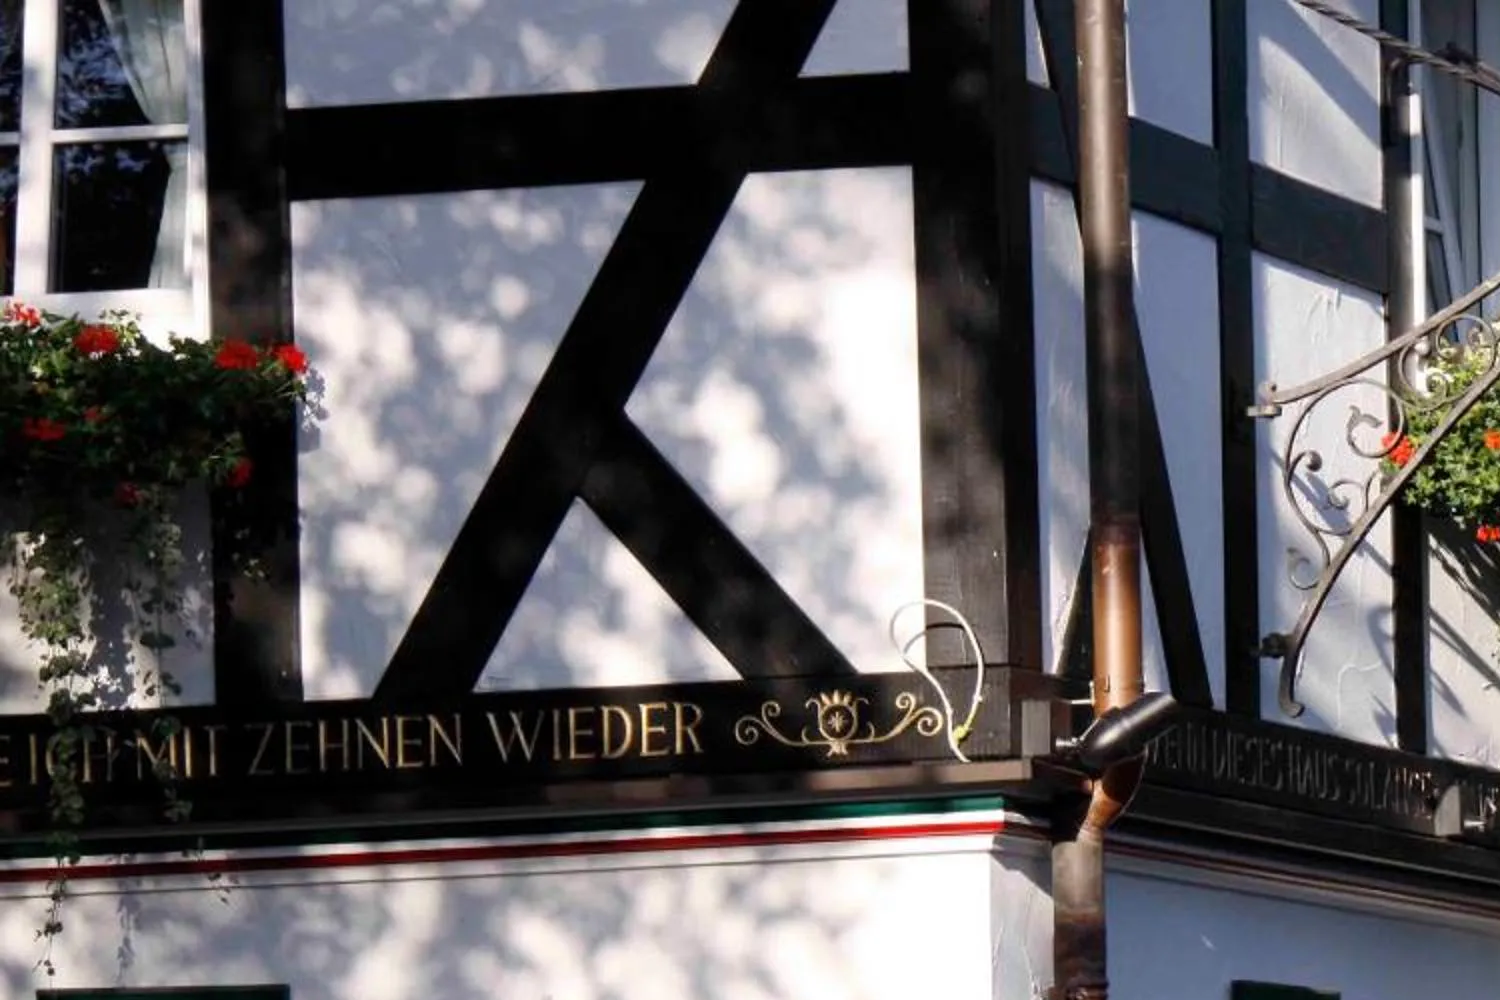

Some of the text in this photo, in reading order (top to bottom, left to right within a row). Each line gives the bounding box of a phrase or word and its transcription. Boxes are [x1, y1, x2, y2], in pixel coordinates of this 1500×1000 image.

[243, 712, 463, 776] ZEHNEN
[486, 701, 704, 764] WIEDER
[1288, 744, 1341, 801] HAUS
